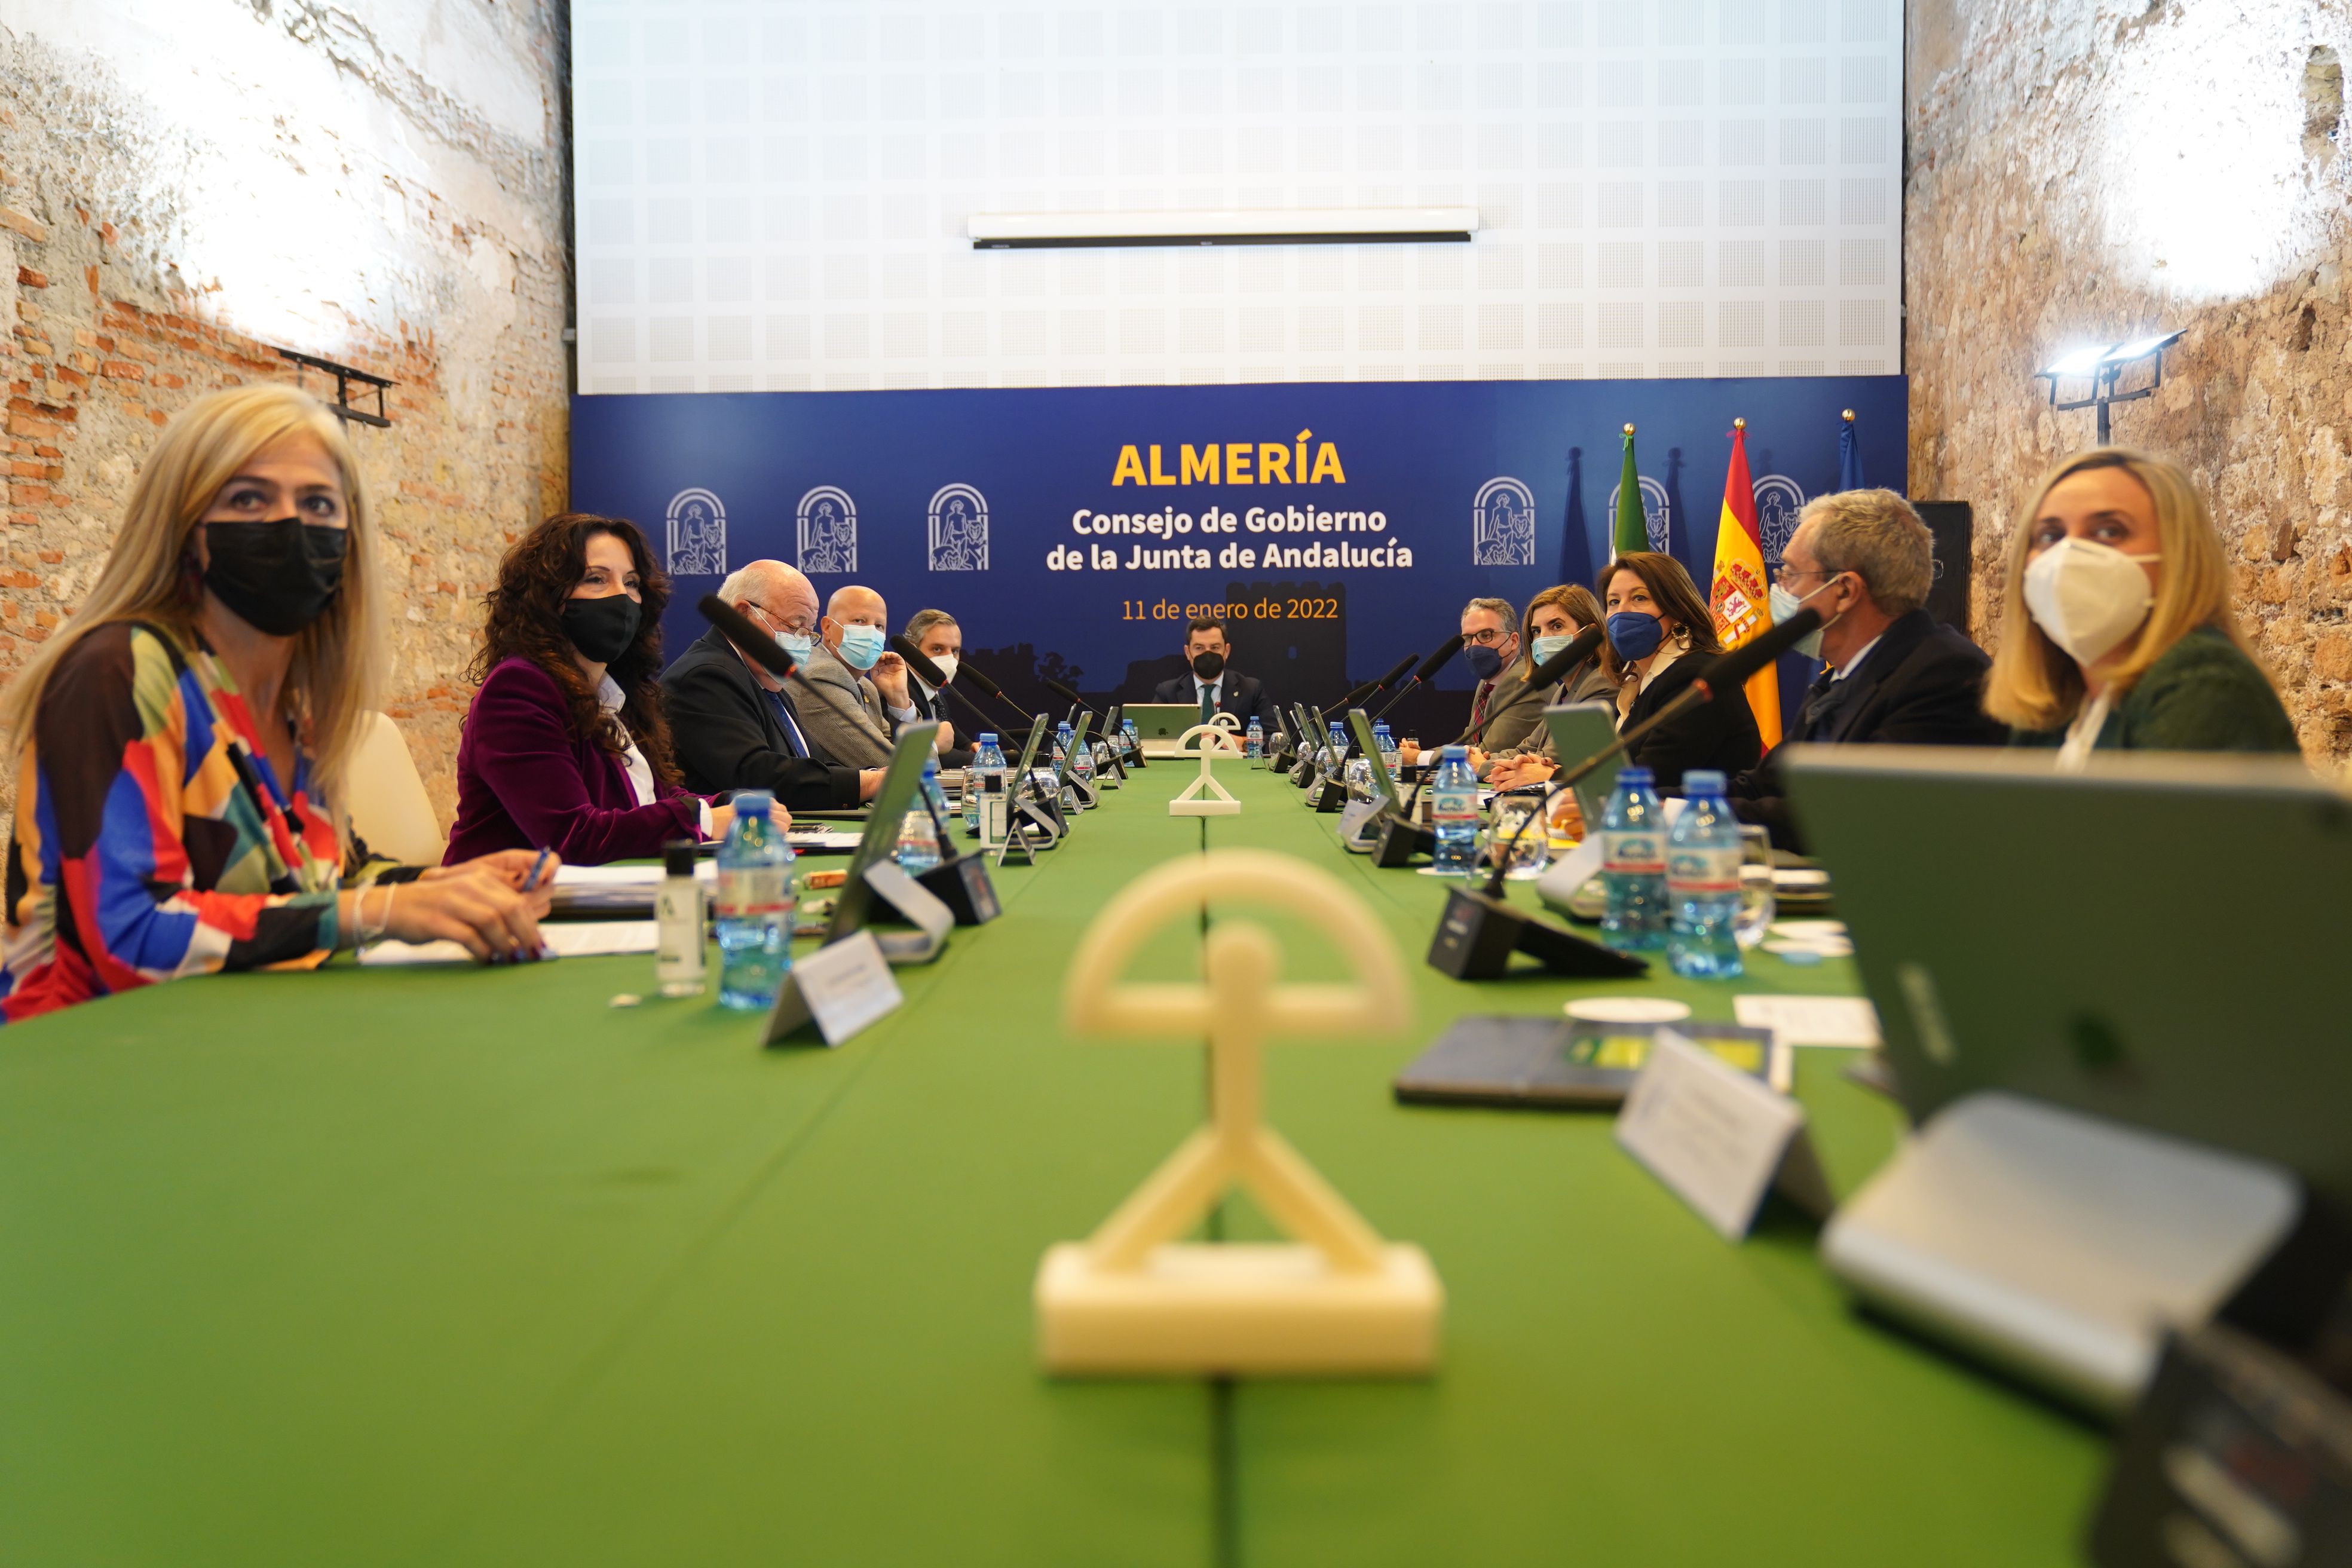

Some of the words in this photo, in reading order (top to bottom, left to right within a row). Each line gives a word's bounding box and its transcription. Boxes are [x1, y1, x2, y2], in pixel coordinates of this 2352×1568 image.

[1111, 428, 1346, 486] ALMERÍA
[1072, 506, 1193, 540] Consejo
[1200, 506, 1238, 533] de
[1245, 504, 1387, 533] Gobierno
[1046, 544, 1083, 571] de
[1091, 543, 1117, 570] la
[1125, 544, 1211, 570] Junta
[1218, 542, 1256, 569] de
[1262, 537, 1413, 568] Andalucía
[1122, 601, 1147, 620] 11
[1152, 598, 1180, 620] de
[1186, 603, 1248, 620] enero
[1254, 597, 1282, 619] de
[1287, 598, 1339, 619] 2022
